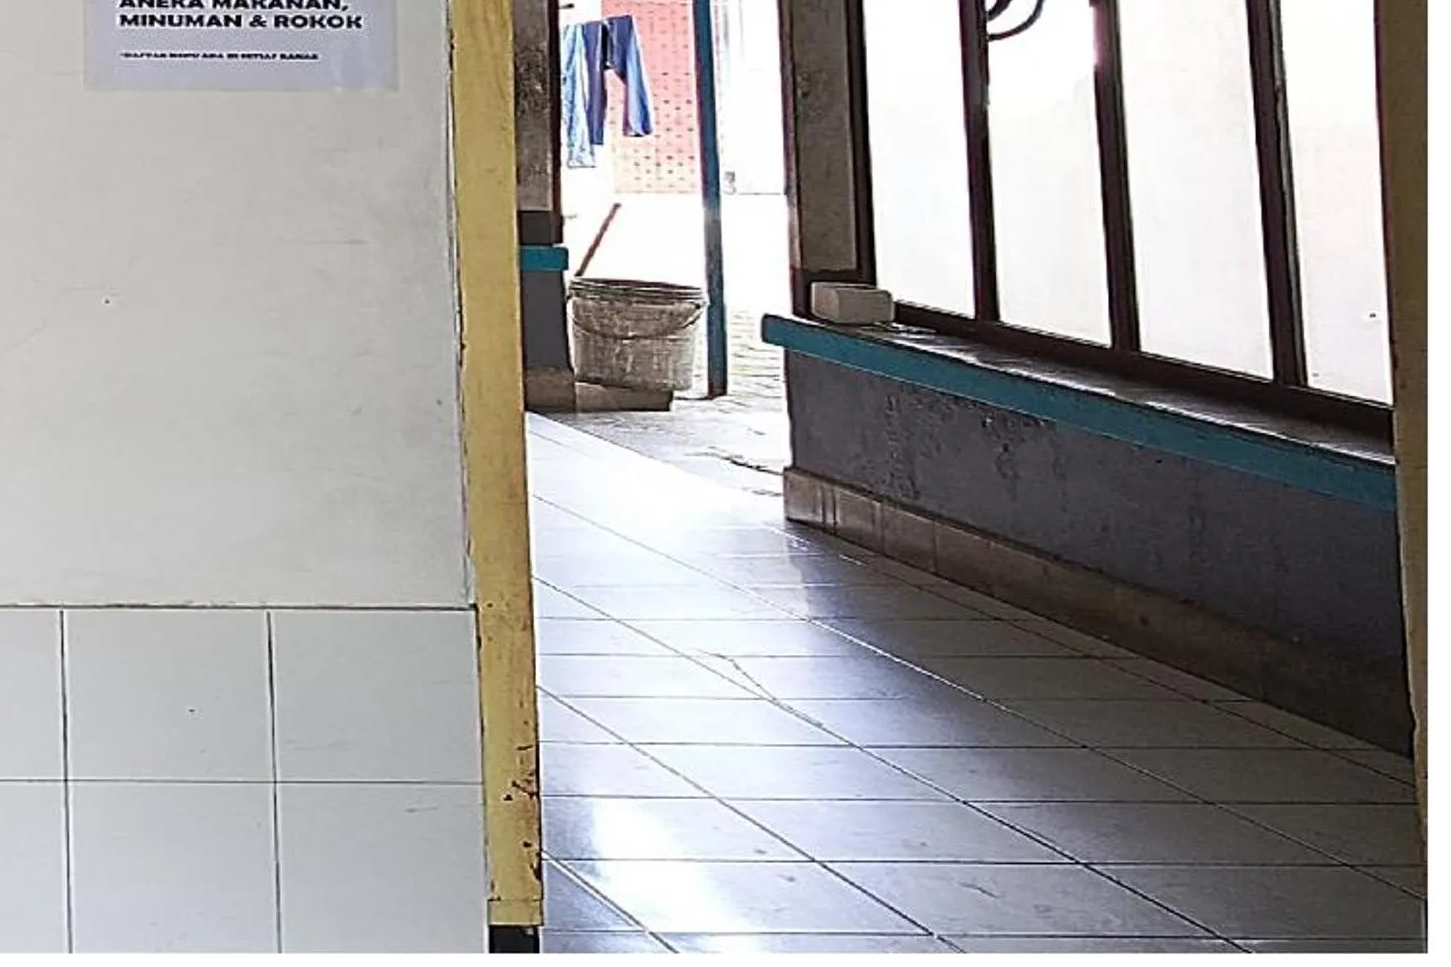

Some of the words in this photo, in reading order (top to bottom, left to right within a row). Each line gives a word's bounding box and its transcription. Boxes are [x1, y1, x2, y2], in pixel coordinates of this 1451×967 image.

[119, 14, 243, 29] MINUMAN
[248, 15, 268, 29] &
[273, 15, 364, 31] ROKOK
